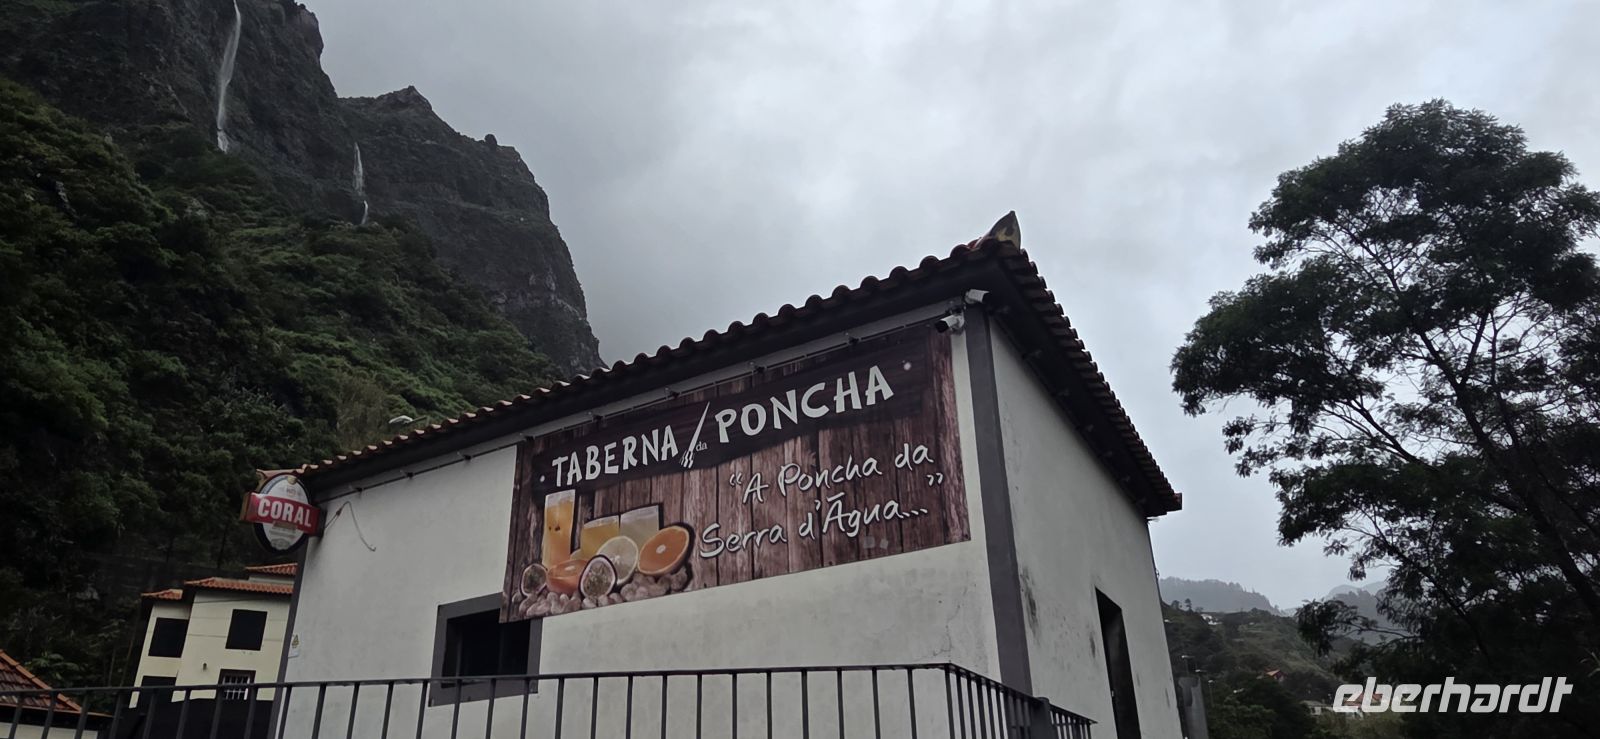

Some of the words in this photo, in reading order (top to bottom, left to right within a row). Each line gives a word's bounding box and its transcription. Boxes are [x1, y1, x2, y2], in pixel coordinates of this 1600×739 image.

[552, 426, 679, 487] TABERNA
[696, 441, 708, 452] da
[715, 365, 894, 443] PONCHA
[778, 454, 883, 496] Poncha
[895, 443, 934, 470] da
[257, 498, 312, 528] CORAL
[700, 523, 787, 558] Serra
